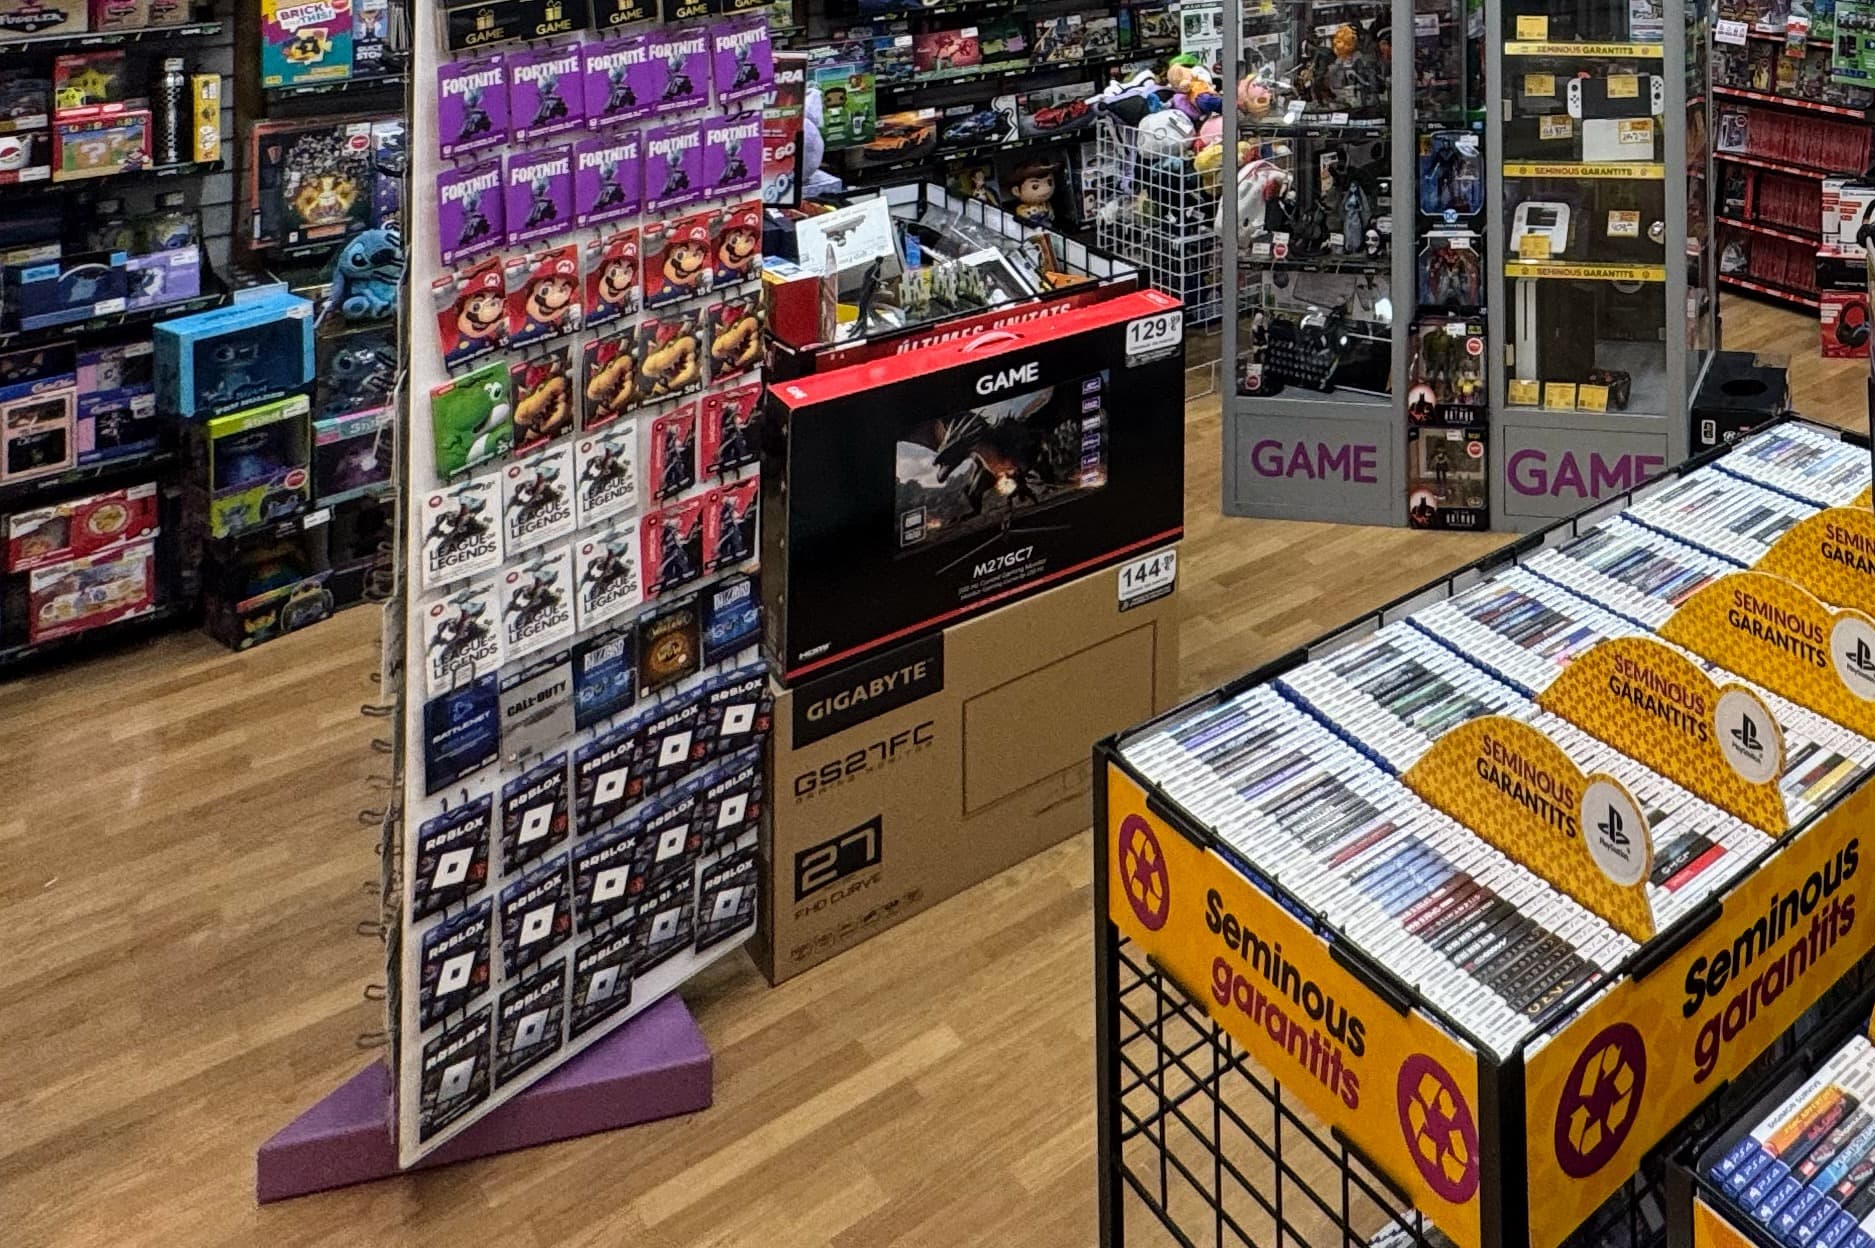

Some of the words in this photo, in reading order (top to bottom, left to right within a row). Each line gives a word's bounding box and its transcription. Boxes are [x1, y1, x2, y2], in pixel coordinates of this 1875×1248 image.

[280, 1, 329, 21] BRICK!
[610, 8, 643, 23] GAME
[676, 3, 707, 18] GAME
[465, 27, 504, 44] GAME
[536, 19, 572, 35] GAME
[716, 27, 767, 52] FORTNITE
[587, 47, 648, 74] FORTNITE
[649, 38, 706, 62] FORTNITE
[1536, 45, 1582, 54] SEMINOUS
[1584, 45, 1633, 55] GARANTITS
[442, 68, 502, 97] FORTNITE
[514, 57, 579, 83] FORTNITE
[1535, 168, 1579, 176] SEMINOUS
[1581, 168, 1633, 177] GARANTITS
[1536, 268, 1581, 277] SEMINOUS
[1584, 269, 1634, 278] GARANTITS
[976, 362, 1039, 395] GAME
[1251, 439, 1377, 484] GAME
[510, 503, 561, 527] LEAGUE
[511, 511, 570, 539] LEGENDS
[429, 536, 487, 559] LEAGUE
[429, 544, 496, 572] LEGENDS
[973, 546, 1034, 579] M27GC7
[1733, 589, 1824, 644] SEMINOUS
[1728, 608, 1828, 670] GARANTITS
[507, 698, 535, 717] CALL
[538, 679, 567, 705] DUTY
[711, 678, 762, 704] ROBLOX
[806, 660, 926, 722] GIGABYTE
[1614, 654, 1706, 715] SEMINOUS
[648, 705, 698, 735] ROBLOX
[1608, 675, 1708, 743] GARANTITS
[582, 739, 635, 773] ROBLOX
[794, 721, 934, 797] GS27FC
[1483, 733, 1575, 810] SEMINOUS
[509, 773, 561, 812] ROBLOX
[1476, 758, 1576, 838] GARANTITS
[425, 816, 485, 851] ROBLOX
[802, 827, 876, 892] 27
[794, 900, 827, 921] FHD
[831, 873, 881, 904] CURVE
[1683, 837, 1859, 1019] Seminous
[1206, 888, 1367, 1057] Seminous
[1692, 892, 1857, 1084] garantits
[1210, 955, 1361, 1110] garantits
[1731, 1141, 1753, 1165] PS4
[1745, 1154, 1766, 1178] PS4
